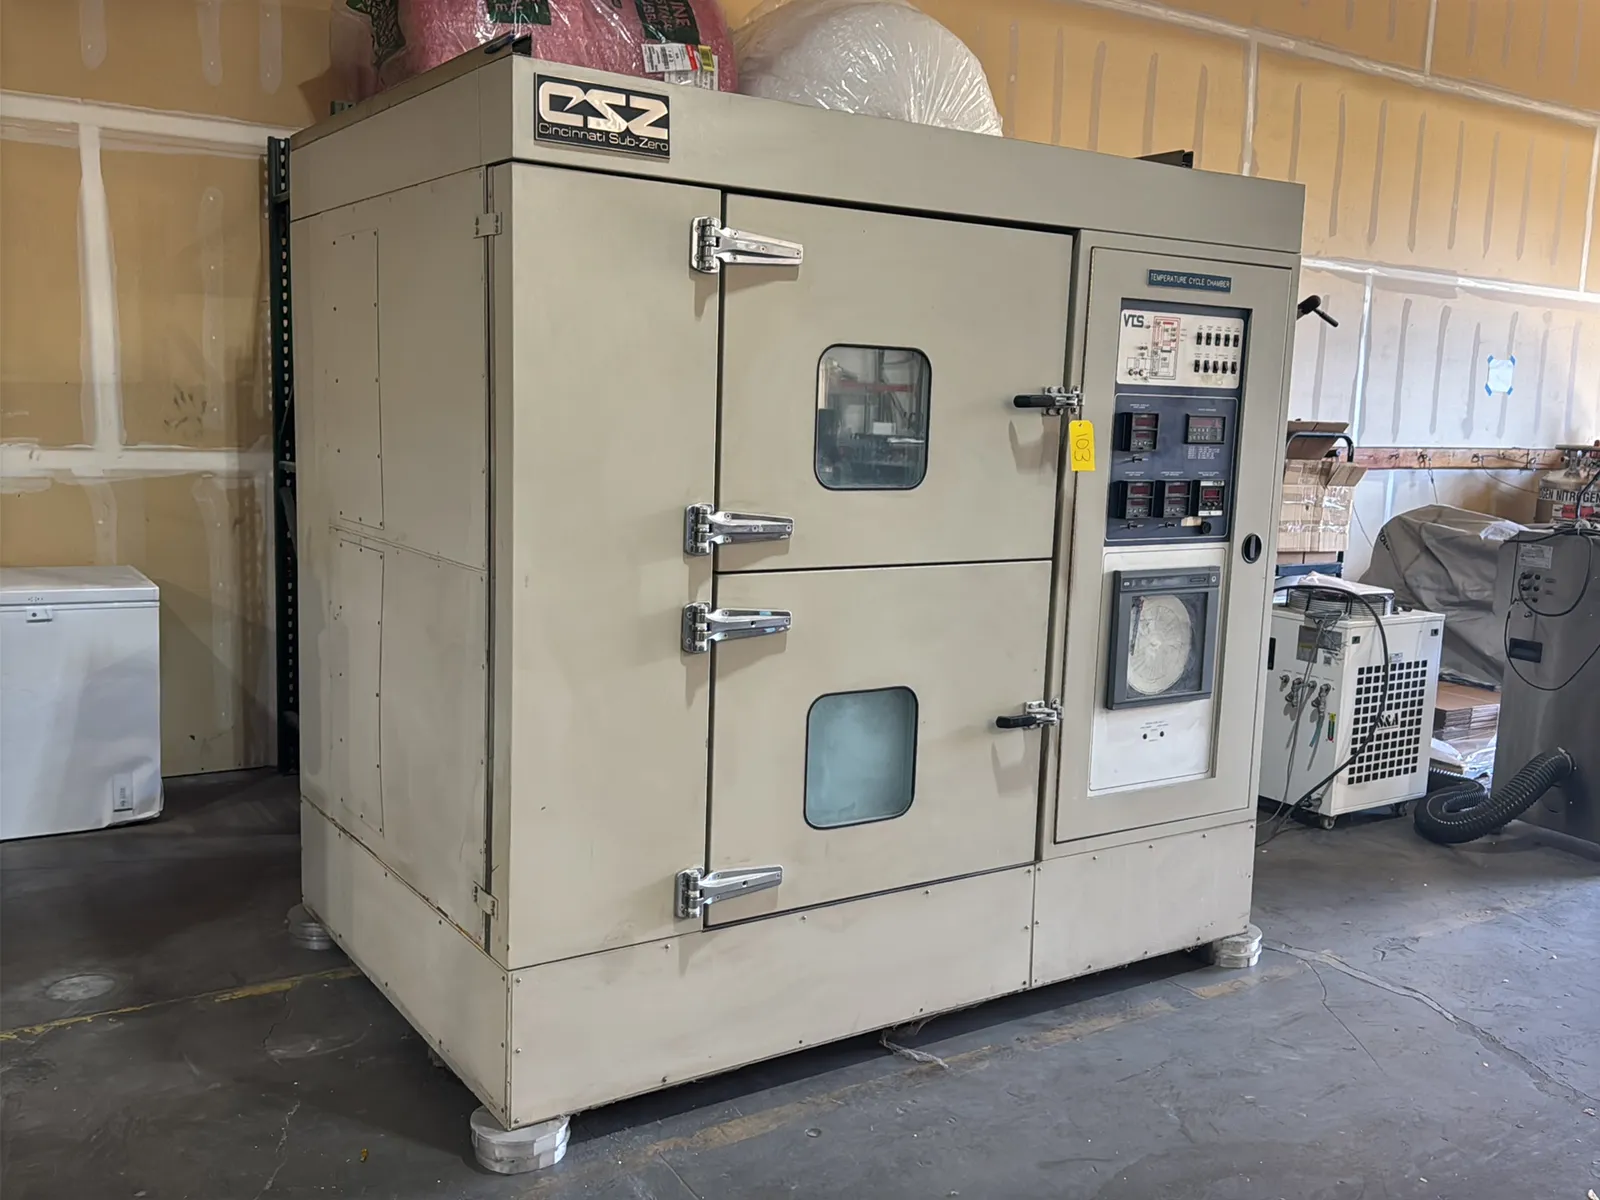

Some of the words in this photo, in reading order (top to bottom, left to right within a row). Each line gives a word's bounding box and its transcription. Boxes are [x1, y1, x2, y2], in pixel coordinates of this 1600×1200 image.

[538, 81, 669, 141] CSZ
[538, 122, 606, 143] Cincinnati
[608, 132, 669, 152] Sub-Zero
[1150, 272, 1188, 284] TEMPERATURE
[1188, 277, 1205, 287] CYCLE
[1206, 278, 1230, 289] CHAMBER
[1123, 313, 1145, 328] VTS
[1074, 433, 1091, 462] 103
